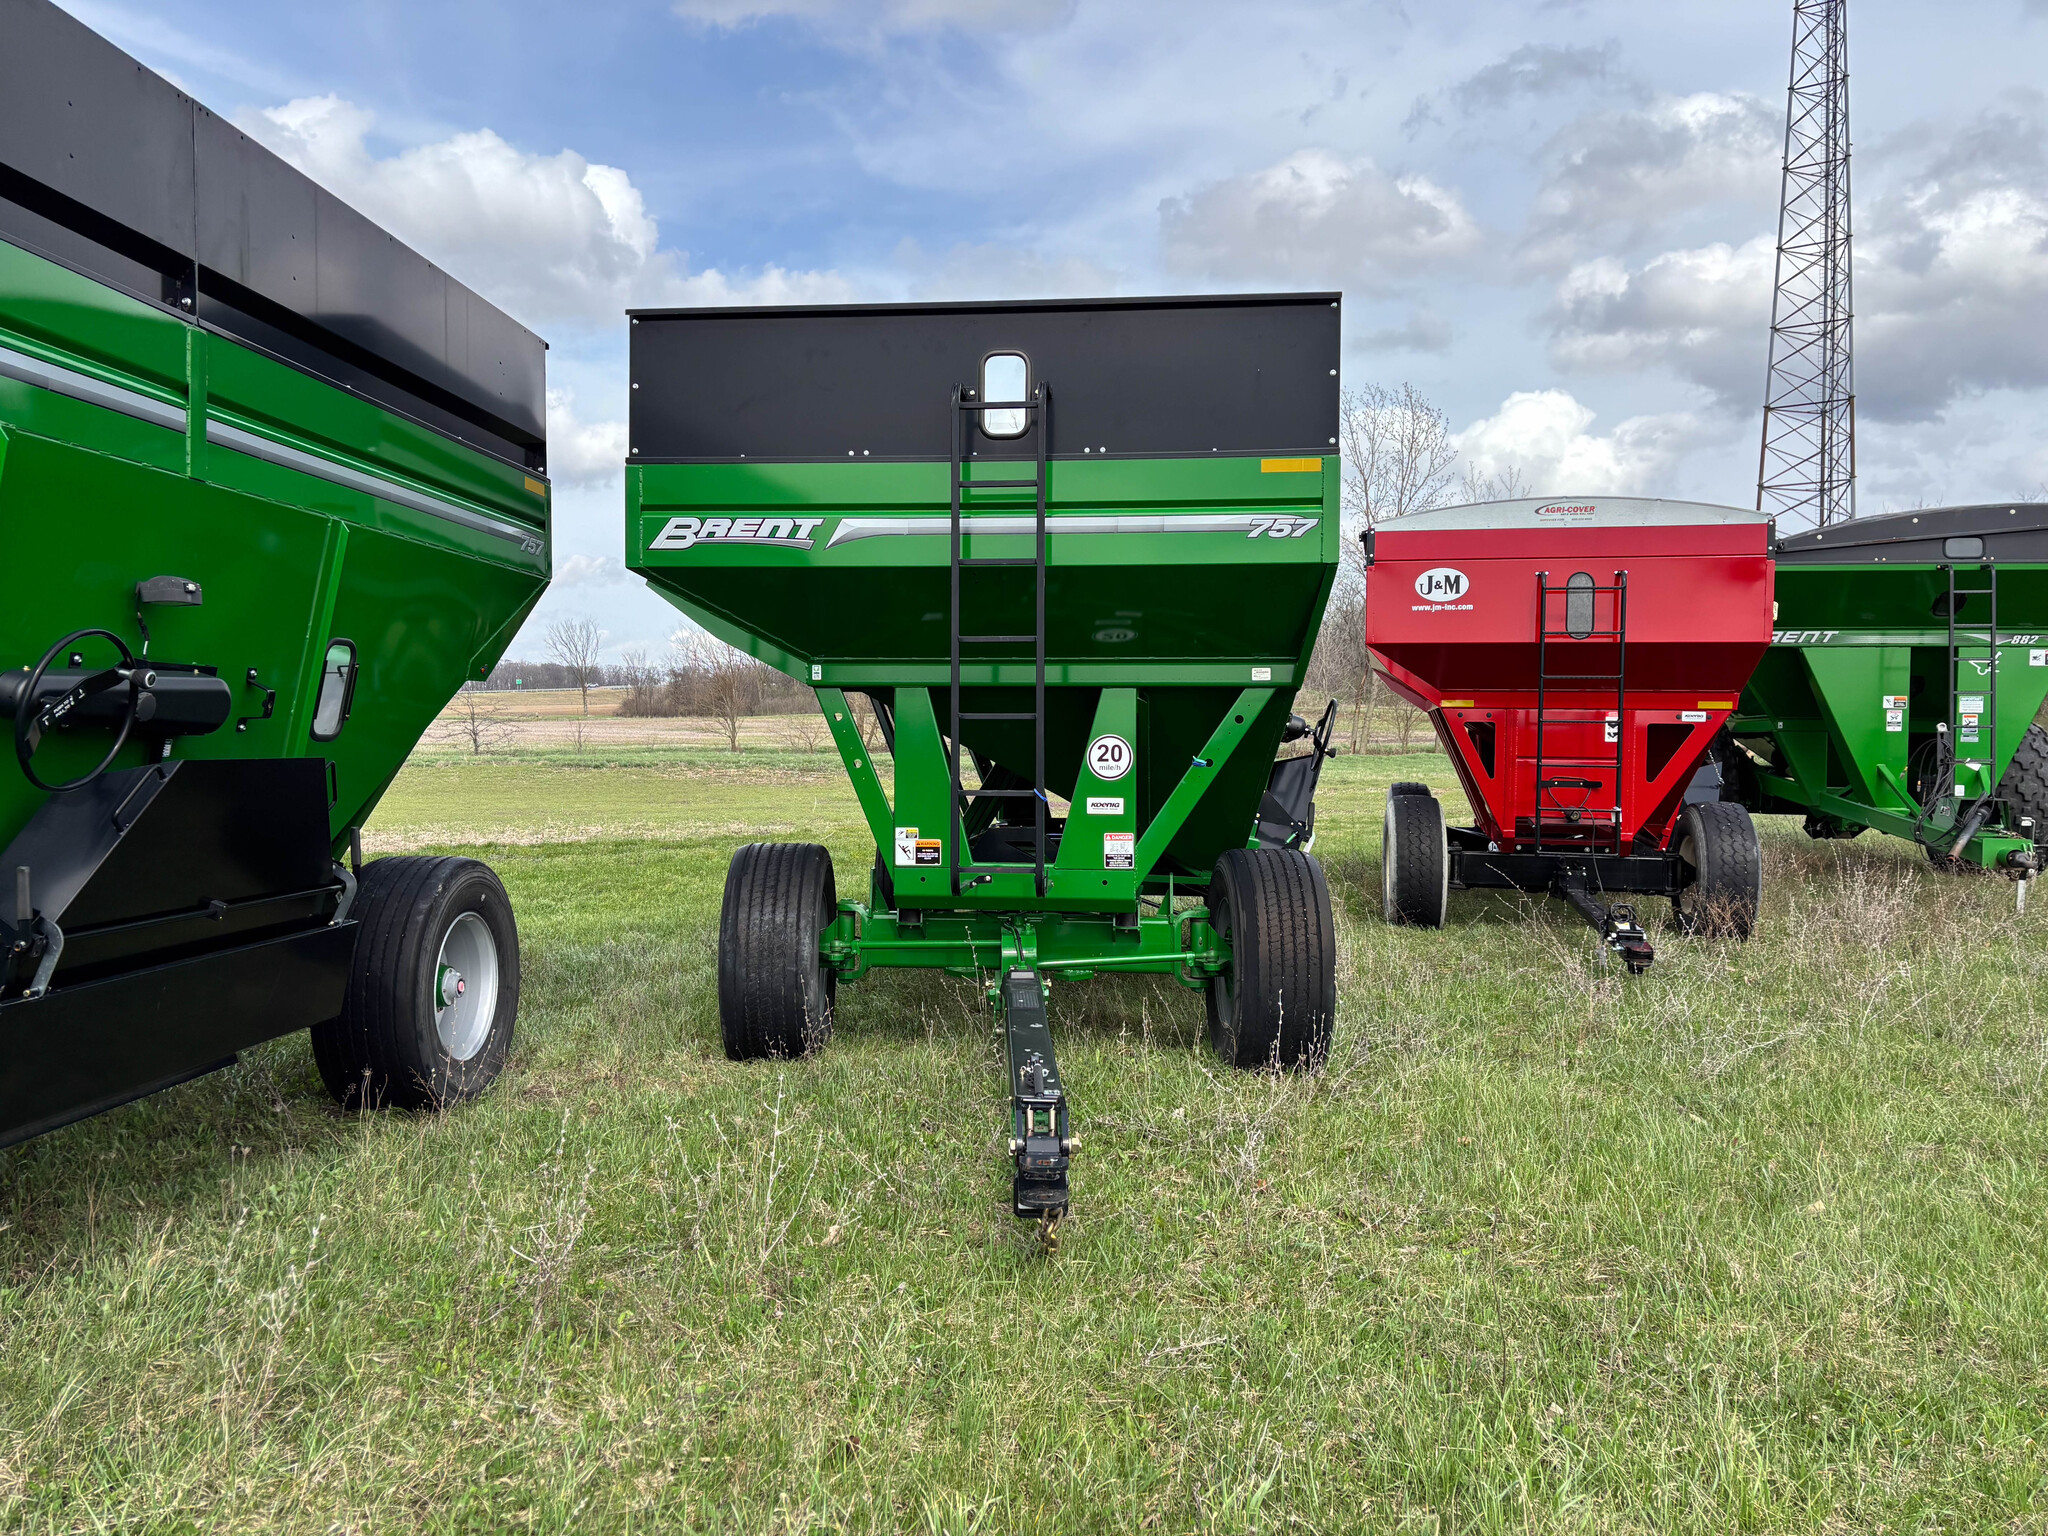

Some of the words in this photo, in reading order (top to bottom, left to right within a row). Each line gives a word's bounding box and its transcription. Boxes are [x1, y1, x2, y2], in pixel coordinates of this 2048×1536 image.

[1544, 505, 1595, 513] AGRI-COVER
[648, 516, 825, 550] BRENT
[1246, 518, 1320, 538] 757
[520, 534, 545, 556] 757
[1419, 574, 1461, 595] J&M
[1411, 603, 1474, 612] www.jm-inc.com
[1771, 630, 1840, 643] RENT
[2010, 634, 2040, 645] 882
[1097, 744, 1123, 762] 20
